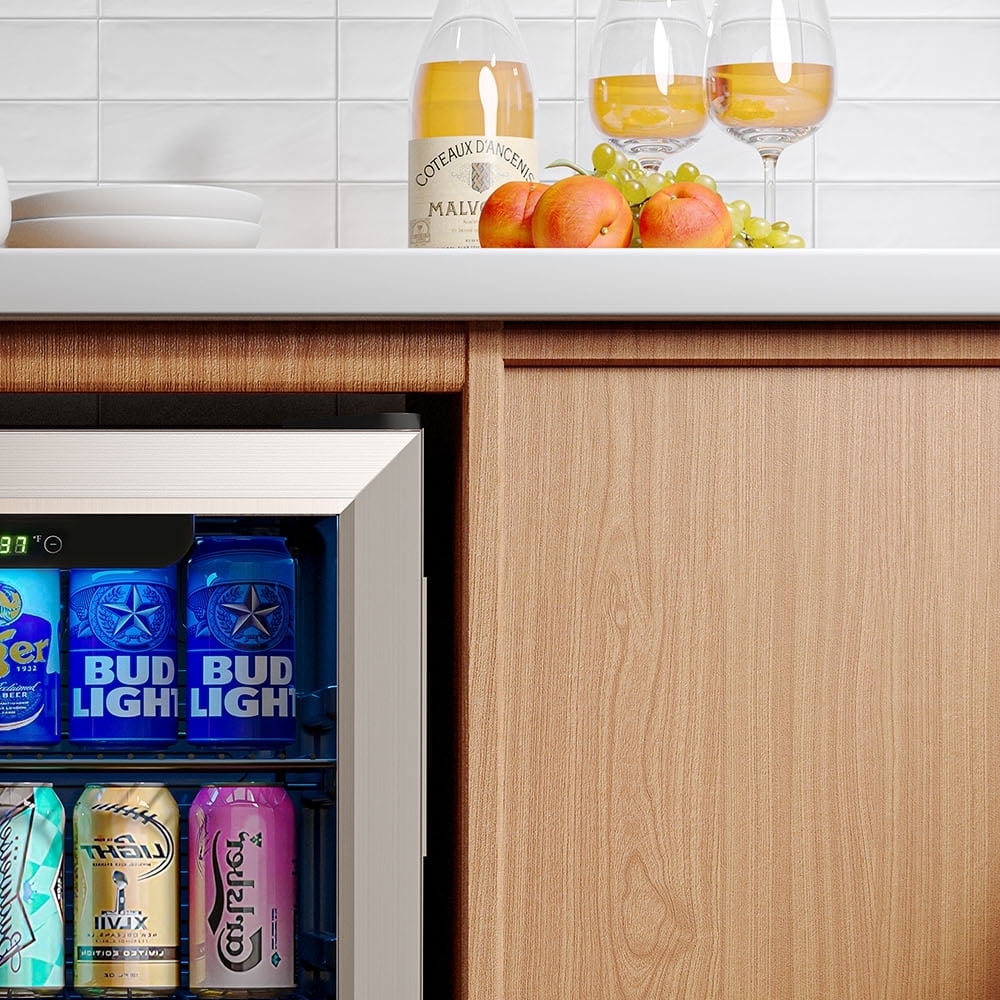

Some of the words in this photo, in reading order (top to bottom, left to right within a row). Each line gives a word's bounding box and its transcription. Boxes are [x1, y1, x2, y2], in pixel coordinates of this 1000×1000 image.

[416, 140, 473, 186] COTEAUX
[476, 139, 535, 182] D'ANCENIS
[0, 536, 27, 554] 37
[84, 656, 175, 686] BUD
[203, 656, 293, 686] BUD
